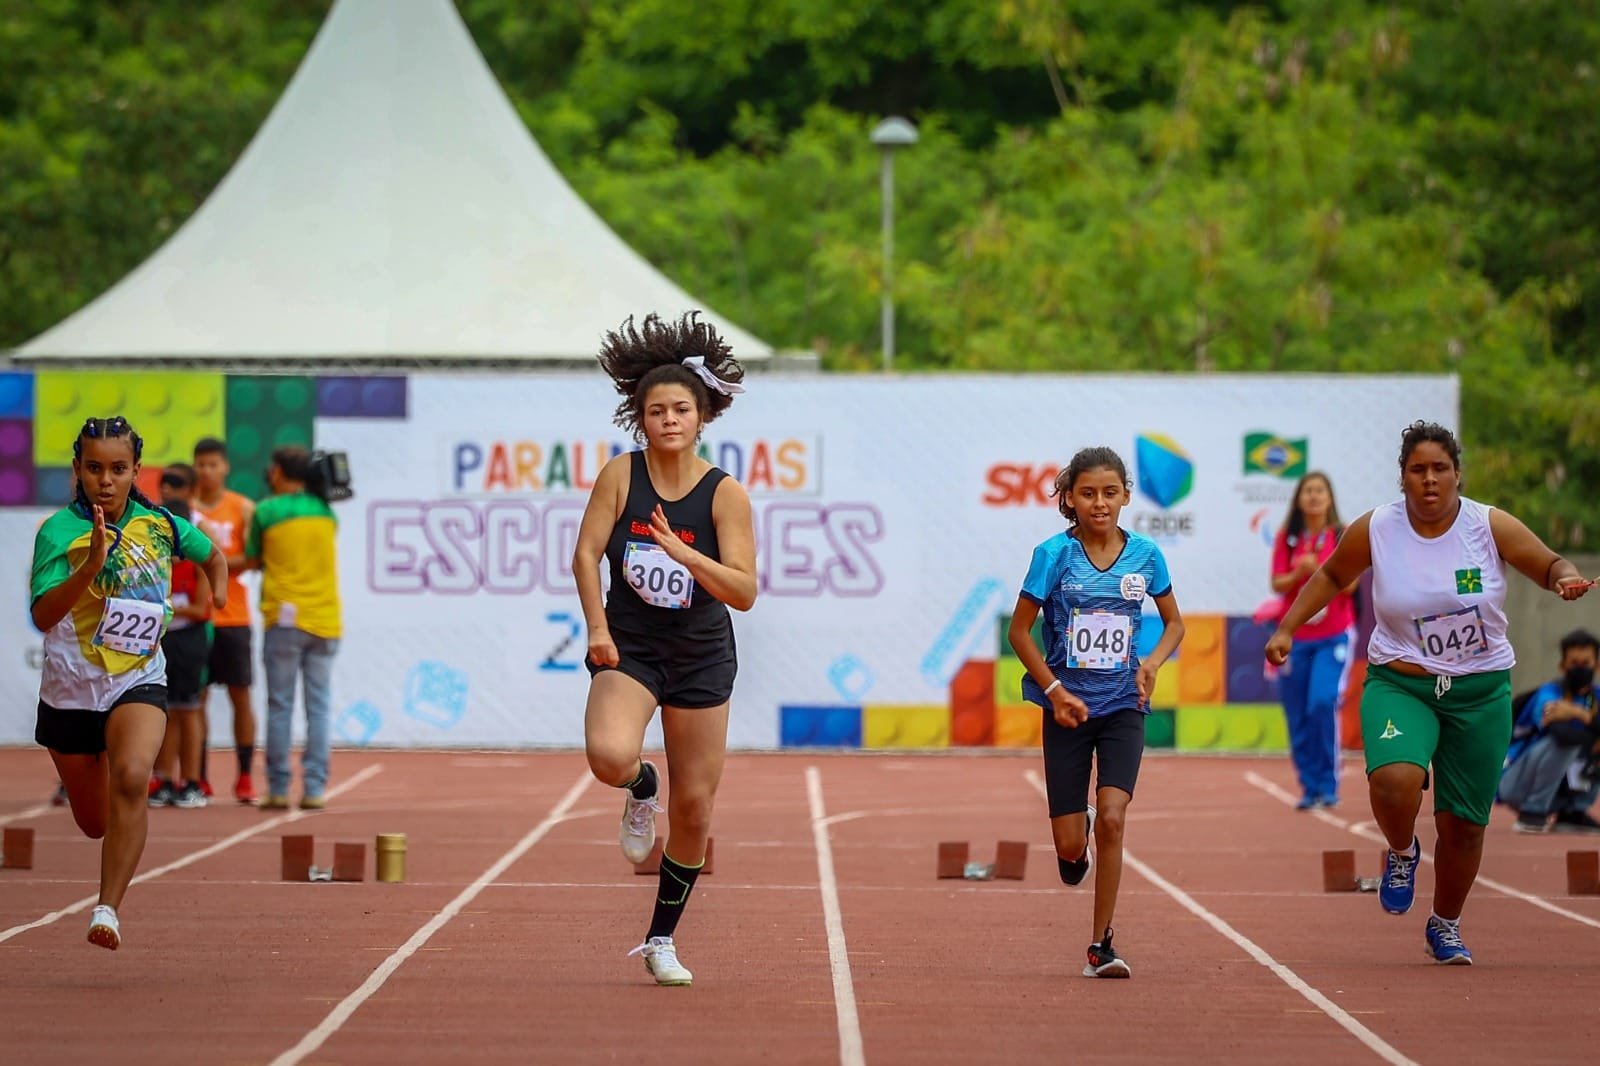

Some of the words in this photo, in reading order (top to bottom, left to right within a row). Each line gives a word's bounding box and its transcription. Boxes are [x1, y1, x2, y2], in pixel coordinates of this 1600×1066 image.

[453, 440, 808, 491] PARALIDAS
[982, 463, 1060, 507] SK
[368, 502, 883, 595] ESCOES
[631, 565, 684, 595] 306
[104, 611, 157, 640] 222
[1076, 628, 1125, 654] 048
[1427, 624, 1479, 656] 042
